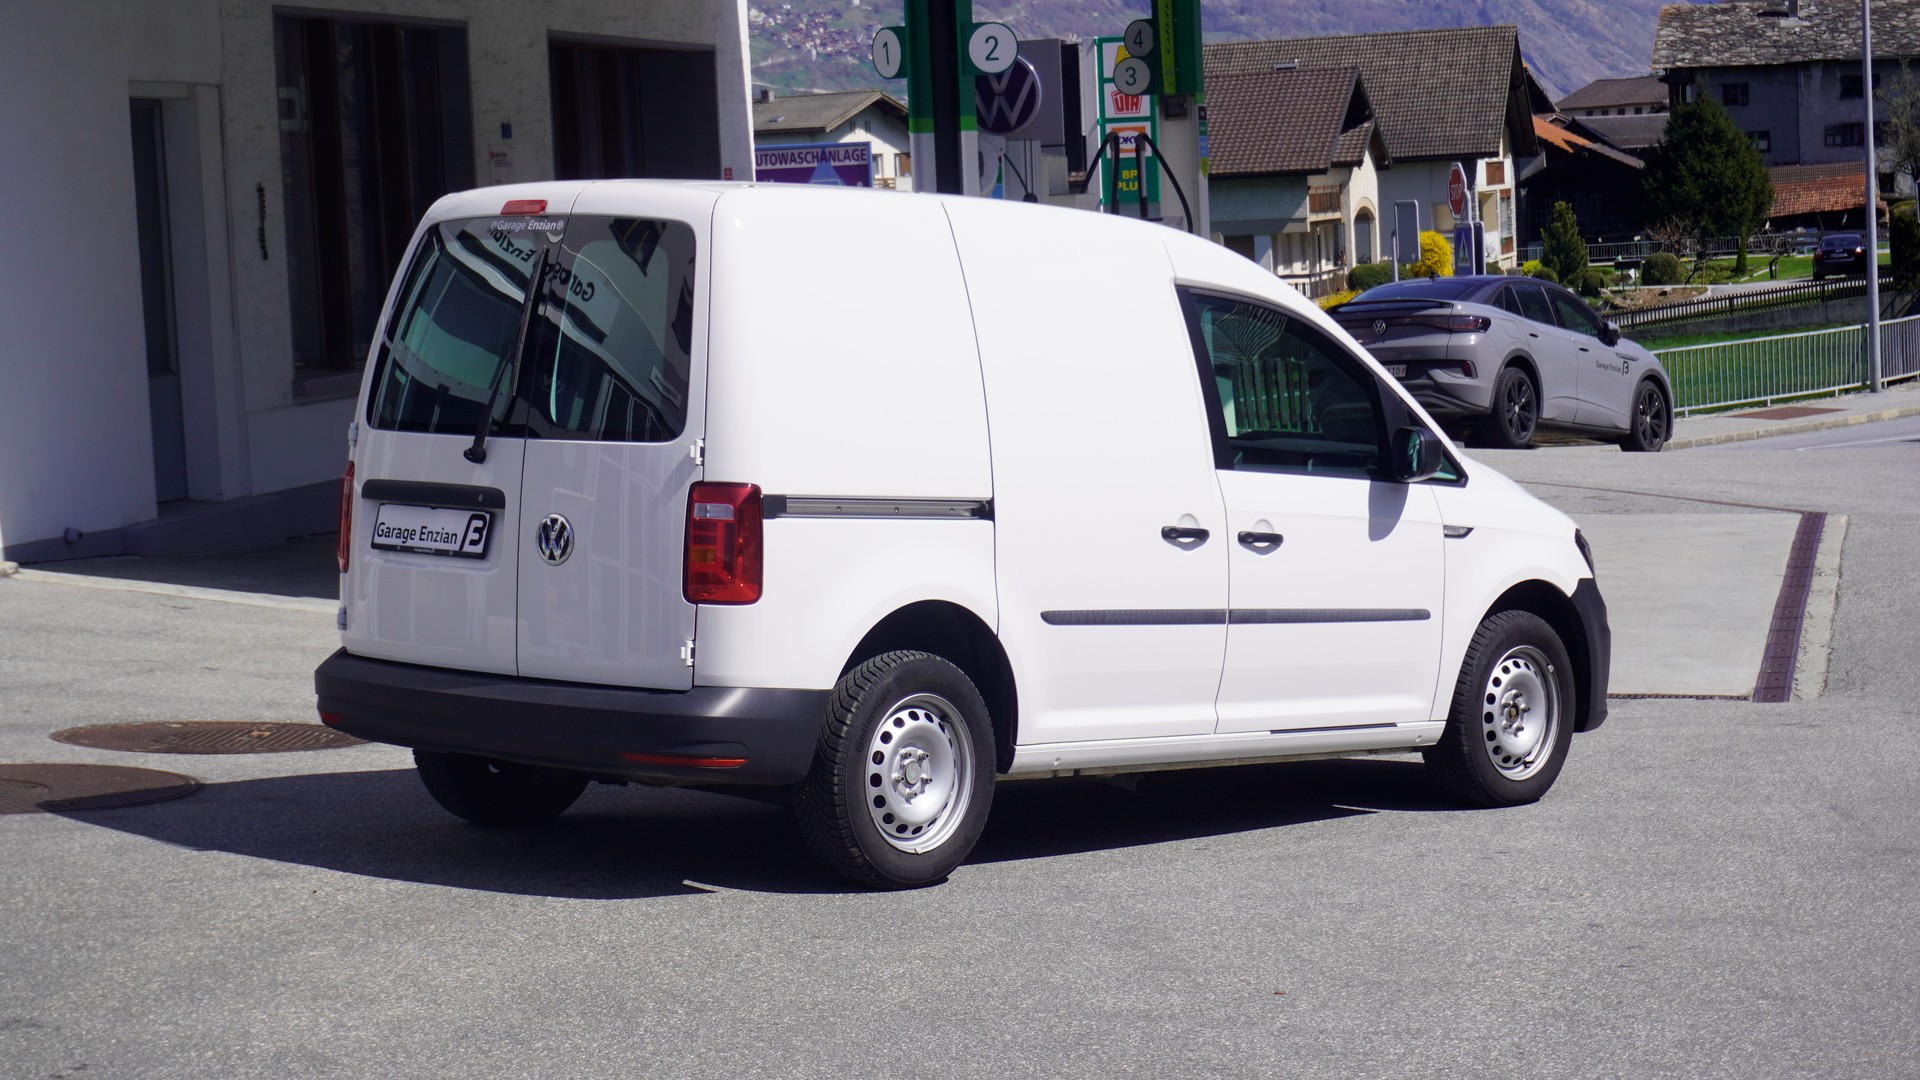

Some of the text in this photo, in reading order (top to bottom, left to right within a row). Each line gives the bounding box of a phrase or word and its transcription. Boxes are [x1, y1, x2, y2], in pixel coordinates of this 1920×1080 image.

[1133, 29, 1144, 48] 4
[882, 41, 890, 66] 1
[984, 35, 1000, 62] 2
[1125, 66, 1137, 87] 3
[755, 148, 867, 167] UTOWASCHANLAGE
[1122, 170, 1138, 180] BP
[1118, 181, 1138, 191] PLU
[497, 219, 557, 232] Garage Enzian
[376, 522, 417, 544] Garage
[419, 526, 458, 544] Enzian
